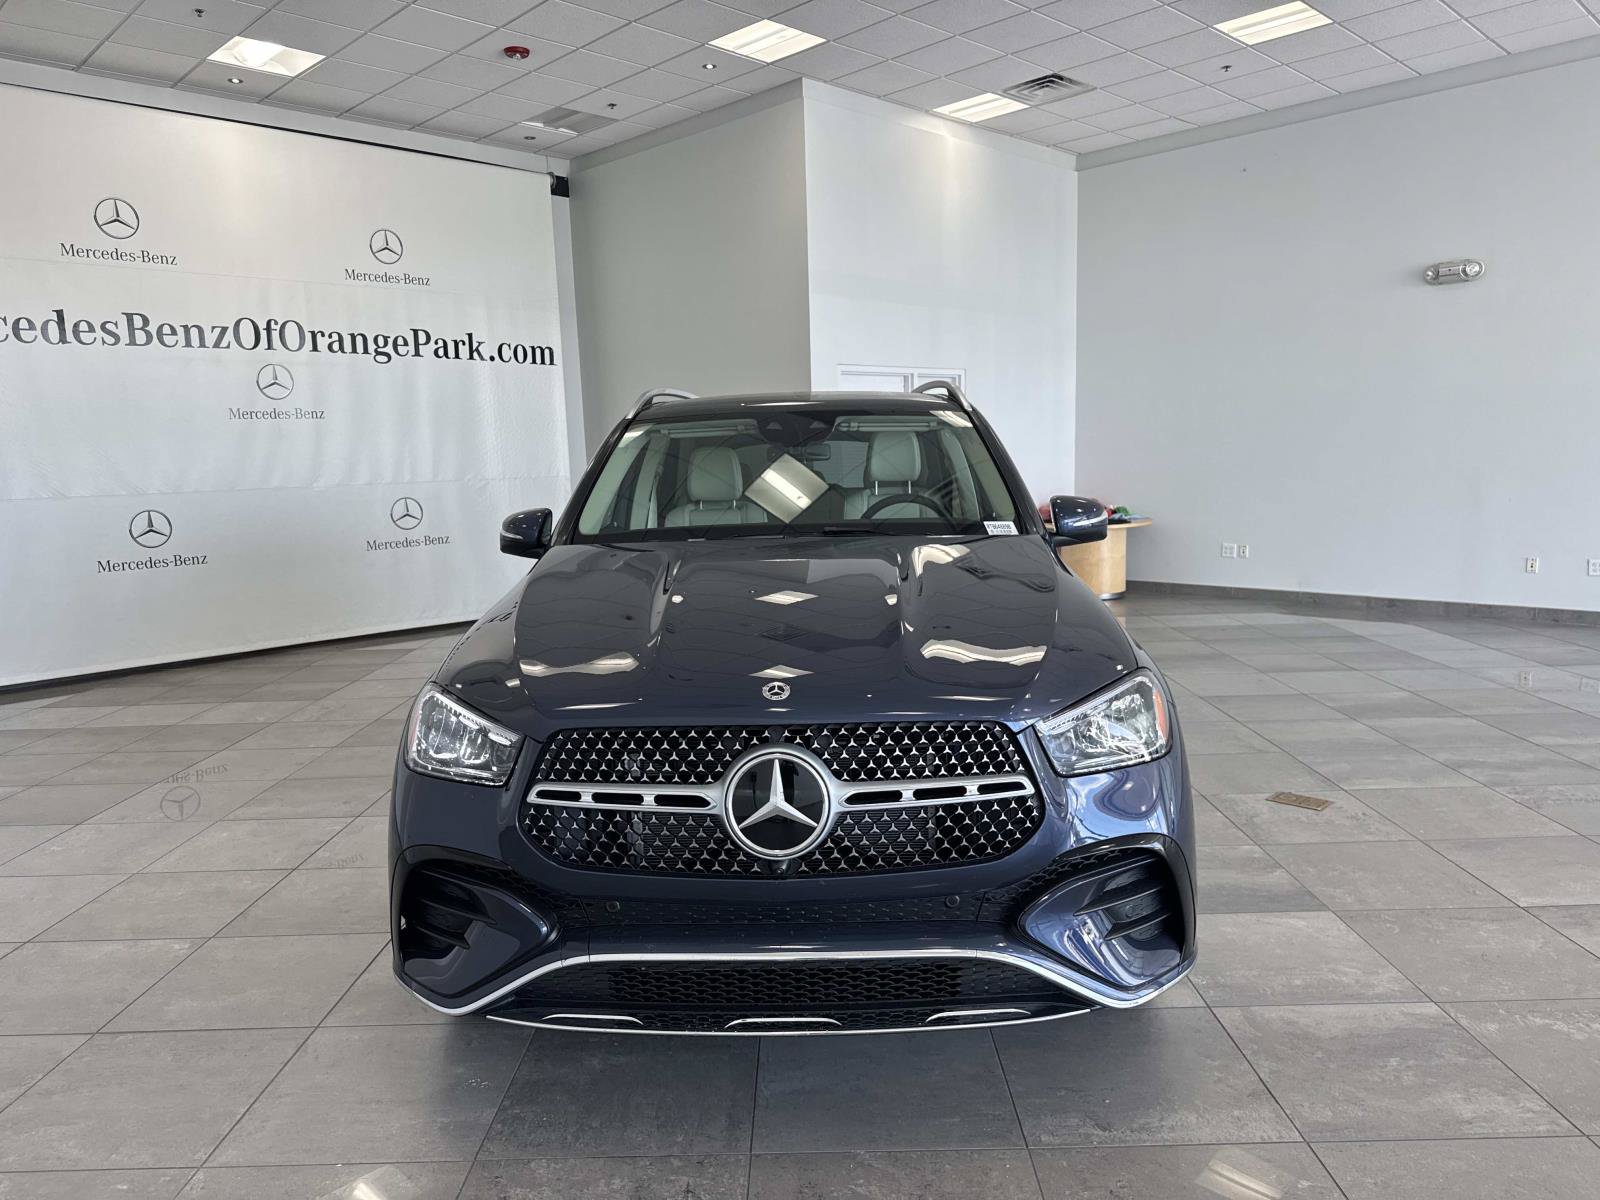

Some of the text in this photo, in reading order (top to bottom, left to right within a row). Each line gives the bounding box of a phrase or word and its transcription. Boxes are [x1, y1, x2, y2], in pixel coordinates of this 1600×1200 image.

[60, 242, 178, 266] Mercedes-Benz
[344, 268, 431, 287] Mercedes-Benz
[228, 407, 326, 421] Mercedes-Benz
[366, 534, 451, 552] Mercedes-Benz
[96, 553, 208, 574] Mercedes-Benz
